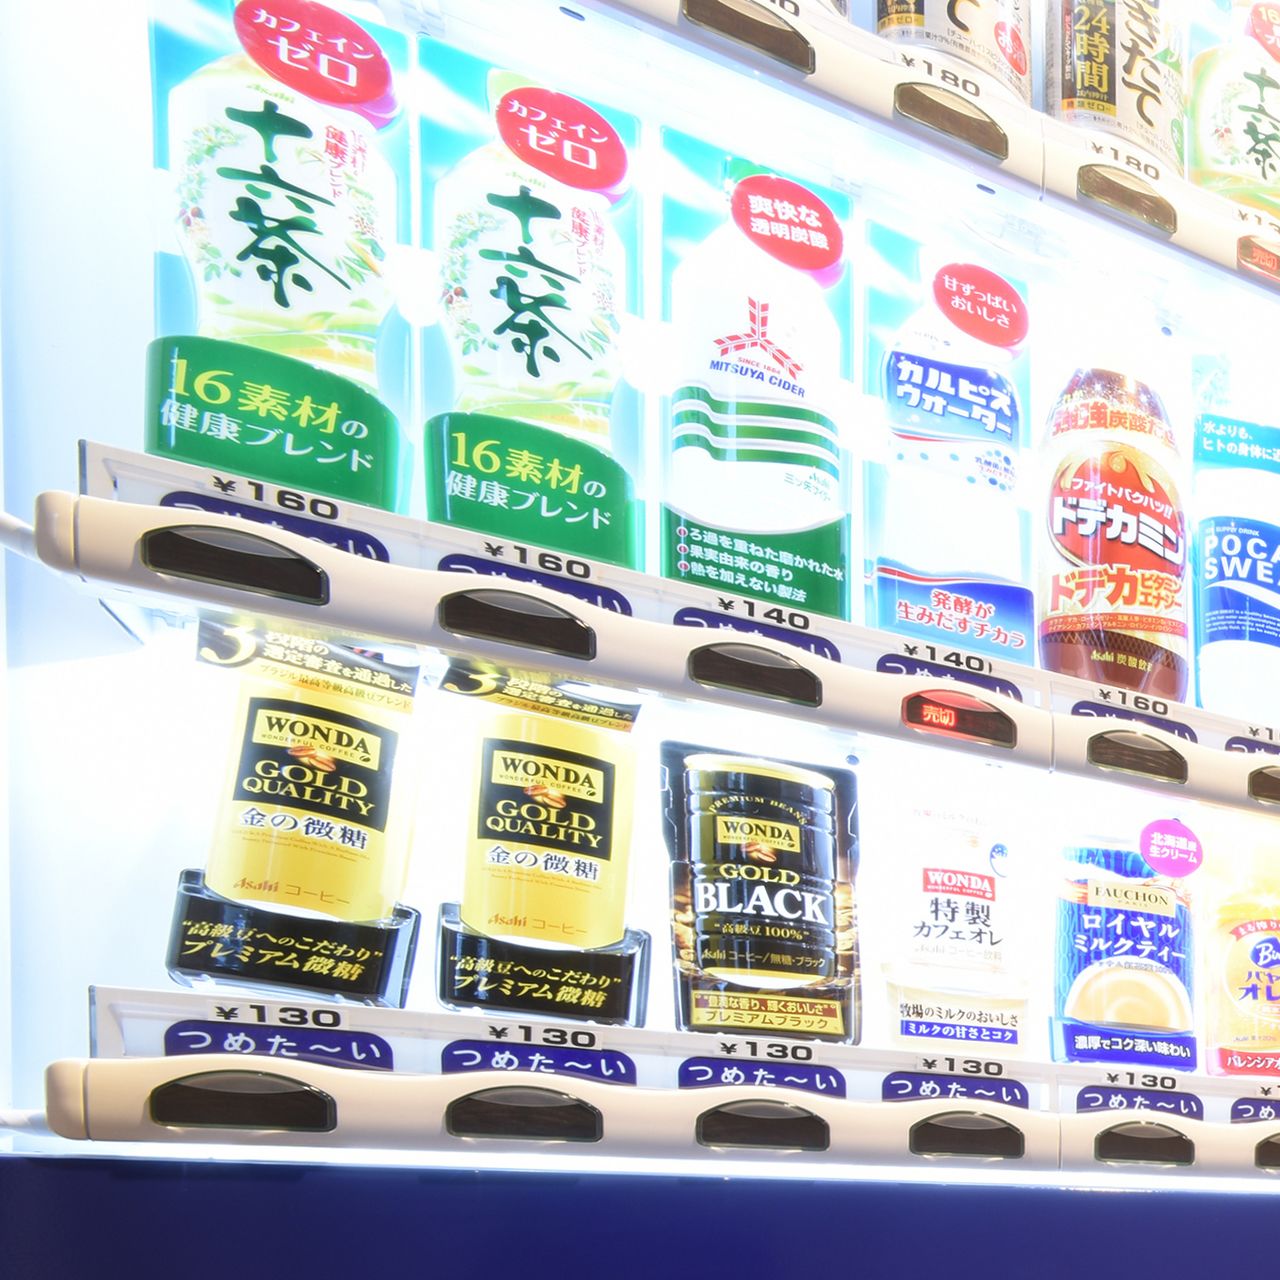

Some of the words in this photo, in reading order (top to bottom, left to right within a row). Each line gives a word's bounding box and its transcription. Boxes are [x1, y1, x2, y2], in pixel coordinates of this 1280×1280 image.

[253, 8, 375, 60] カフェイン
[268, 38, 359, 88] ゼロ
[901, 53, 980, 97] ¥180
[507, 99, 609, 143] カフェイン
[519, 126, 598, 170] ゼロ
[1091, 142, 1160, 180] ¥180
[216, 100, 351, 309] 十六茶
[748, 193, 823, 228] 爽快な
[750, 217, 831, 251] 透明炭酸
[478, 185, 592, 378] 十六茶
[942, 273, 1018, 314] 甘ずっぱい
[950, 294, 1011, 329] おいしさ
[709, 359, 766, 383] MITSUYA
[767, 375, 806, 398] CIDER
[897, 358, 1013, 418] カルピス
[172, 358, 369, 440] 16素材の
[896, 383, 1013, 434] ウォーター
[160, 399, 375, 472] 健康ブレンド
[1203, 421, 1253, 441] 水よりも、
[450, 432, 607, 498] 16素材の
[211, 475, 339, 520] ¥160
[446, 470, 612, 530] 健康ブレンド
[1051, 497, 1184, 565] ドデカミン
[483, 541, 591, 579] ¥160
[689, 526, 845, 583] ろ過を重ねた磨かれた水
[689, 542, 795, 583] 果実由来の香り
[689, 560, 808, 603] 熱を加えない製法
[1050, 565, 1138, 613] ドデカ
[1138, 570, 1183, 594] ビタミン
[717, 596, 811, 632] ¥140
[932, 589, 993, 620] 発酵が
[1140, 589, 1183, 610] エナジー
[897, 600, 1026, 648] 生みだすチカラ
[903, 642, 984, 675] ¥140
[922, 704, 956, 728] 売切
[1098, 687, 1169, 717] ¥160
[261, 733, 315, 748] WONDERFUL
[319, 743, 355, 758] COFFEE
[265, 715, 372, 756] WONDA
[254, 760, 369, 798] GOLD
[501, 756, 597, 790] WONDA
[242, 777, 376, 817] QUALITY
[708, 796, 765, 814] PREMIUM
[240, 807, 368, 850] 金の微糖
[486, 815, 603, 849] QUALITY
[496, 799, 596, 831] GOLD
[722, 820, 794, 843] WONDA
[488, 846, 599, 881] 金の微糖
[1149, 844, 1198, 865] 生クリーム
[234, 877, 279, 893] Asahi
[285, 884, 351, 905] コーヒー
[719, 862, 801, 888] GOLD
[927, 871, 993, 894] WONDA
[696, 882, 830, 926] BLACK
[930, 897, 991, 928] 特製
[1095, 885, 1170, 907] FAUCHON
[488, 913, 528, 928] Asahi
[532, 918, 588, 935] コーヒー
[912, 920, 1004, 947] カフェオレ
[1082, 913, 1180, 939] ロイヤル
[181, 939, 366, 981] プレミアム微糖
[1074, 934, 1187, 963] ミルクティー
[453, 975, 608, 1008] プレミアム微糖
[215, 1004, 341, 1028] ¥130
[705, 1010, 829, 1030] プレミアムブラック
[899, 1003, 1019, 1028] 牧場のミルクのおいしさ
[908, 1022, 1014, 1042] ミルクの甘さとコク
[488, 1025, 596, 1048] ¥130
[720, 1041, 813, 1062] ¥130
[1074, 1034, 1191, 1059] 濃厚でコク深い味わい
[922, 1057, 1003, 1077] ¥130
[1106, 1071, 1178, 1090] ¥130
